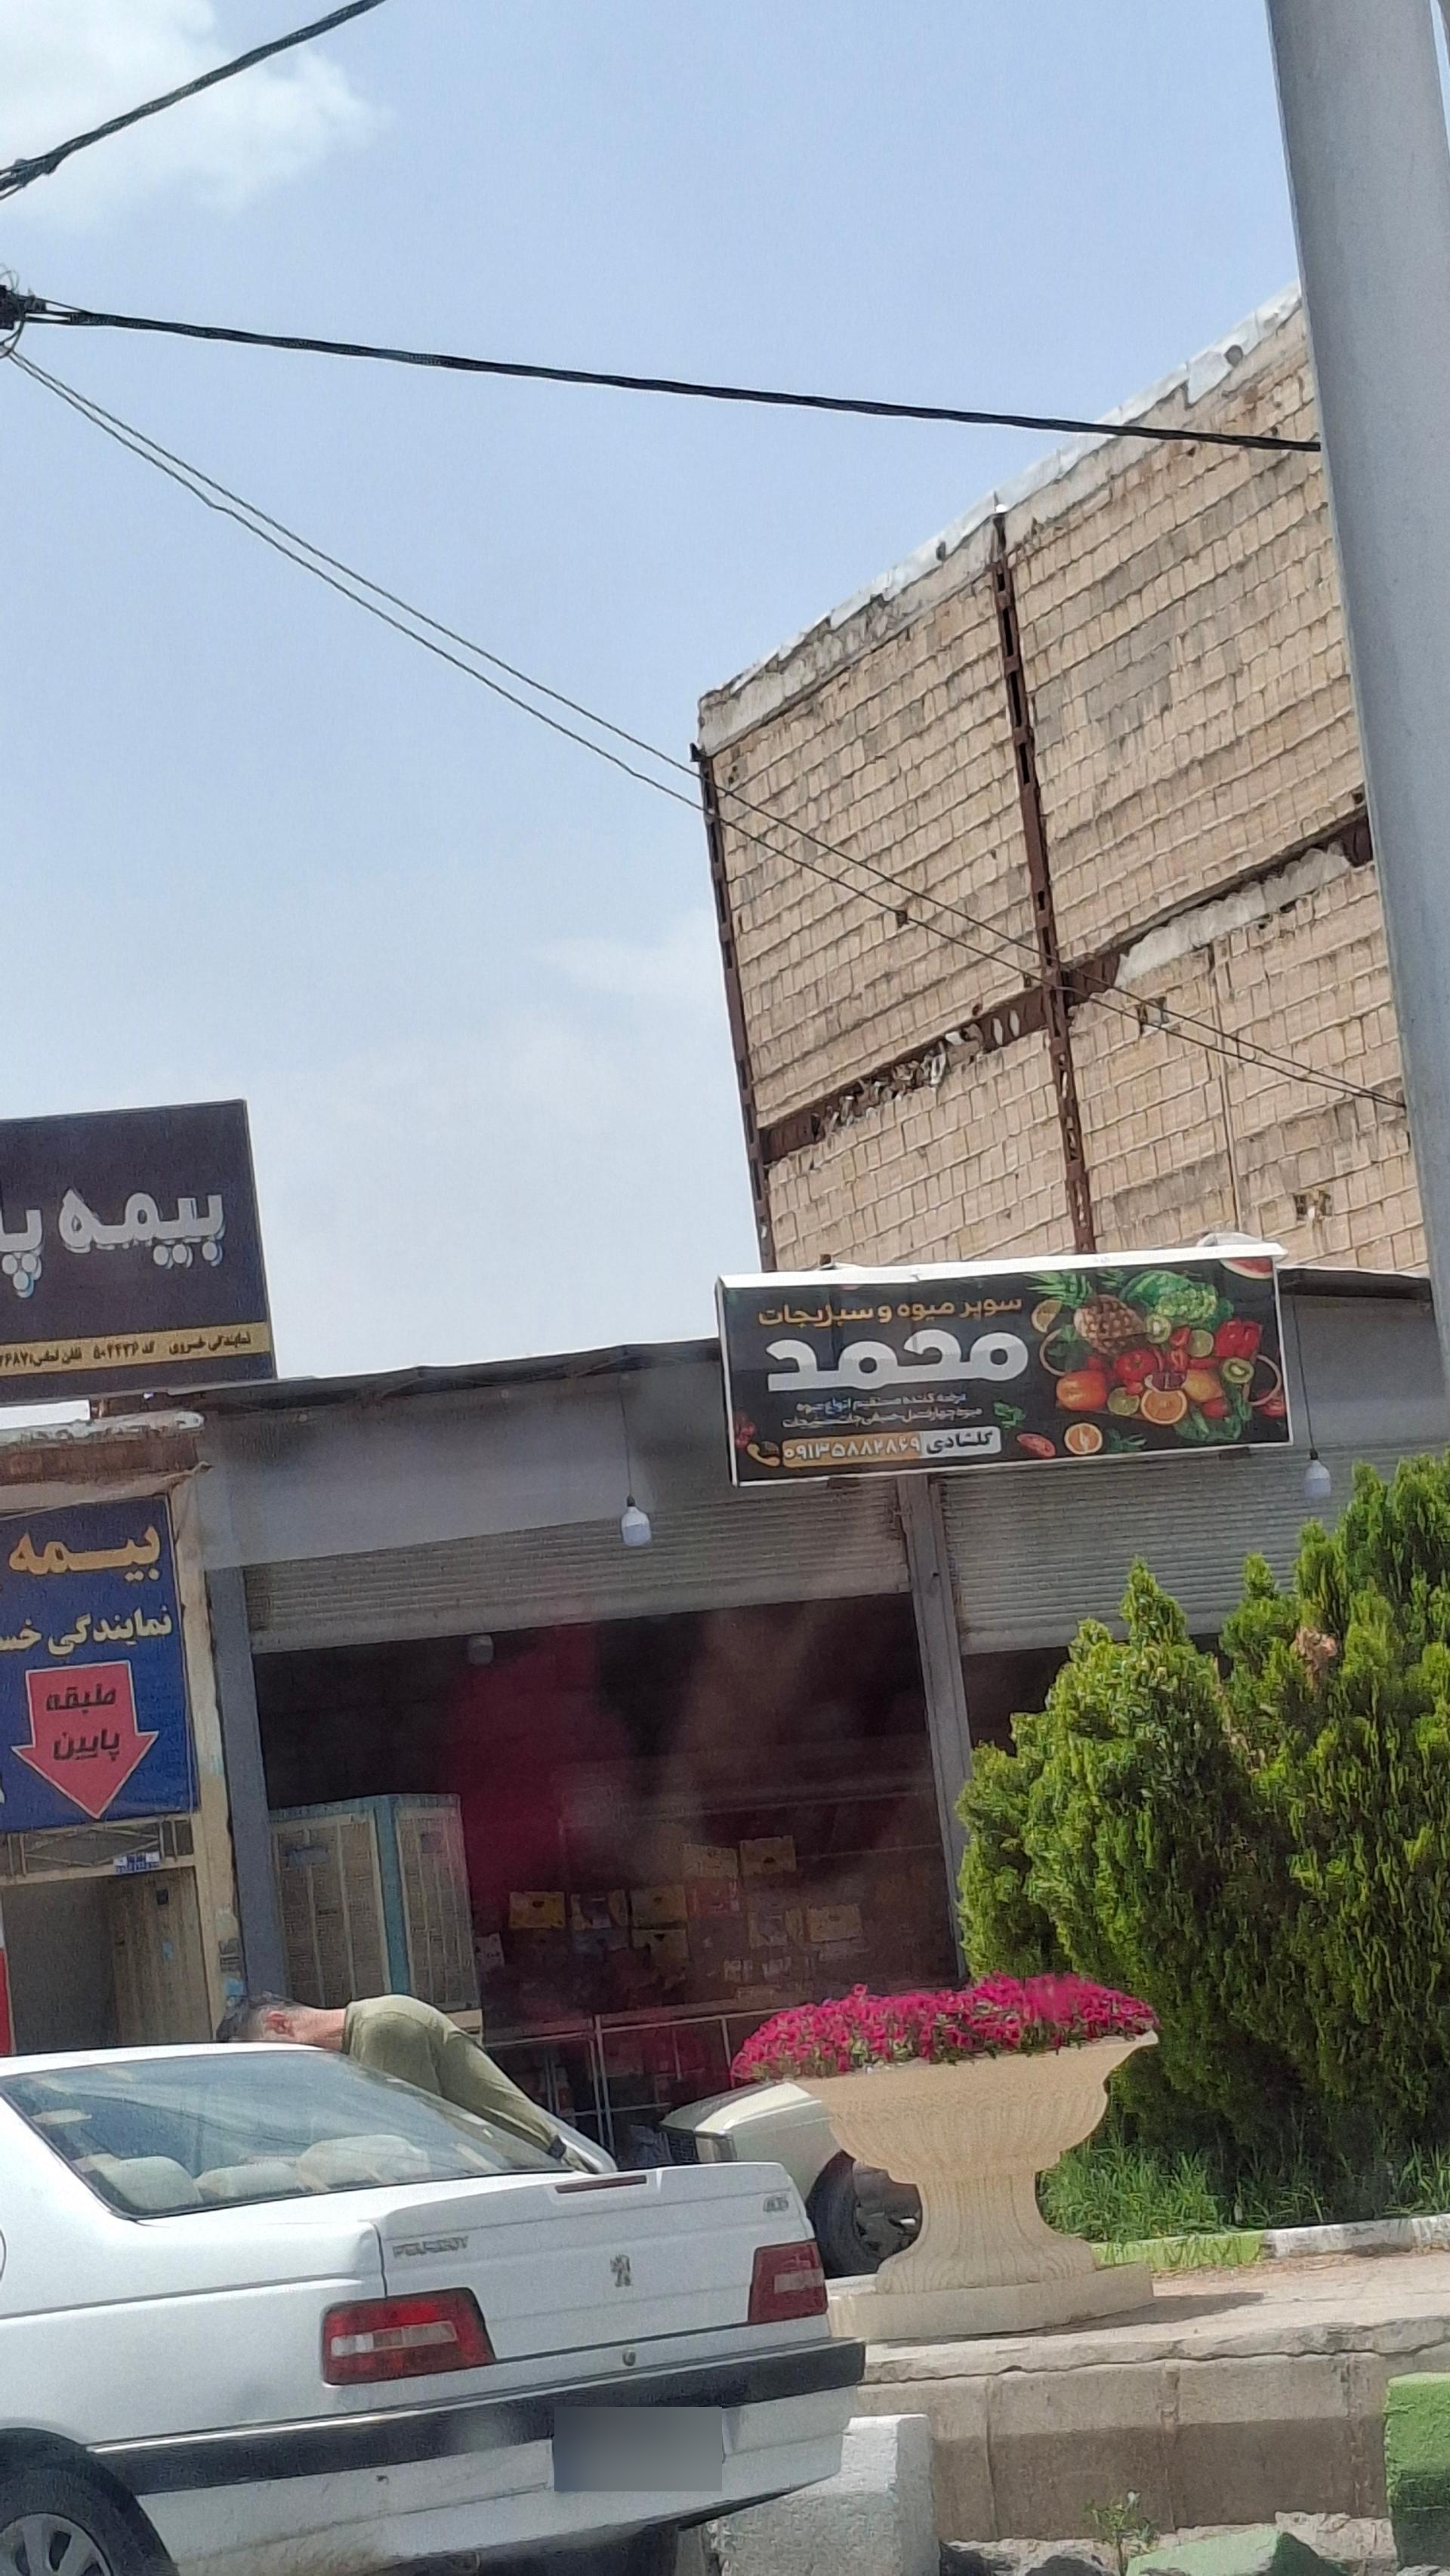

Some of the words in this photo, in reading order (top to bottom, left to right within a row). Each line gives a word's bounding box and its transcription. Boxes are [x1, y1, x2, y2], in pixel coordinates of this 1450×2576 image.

[59, 1188, 224, 1268] بیمه
[758, 1303, 874, 1328] سبزیجات
[878, 1305, 892, 1323] و
[897, 1301, 955, 1321] میوه
[960, 1297, 1023, 1320] سوپر
[765, 1329, 1029, 1391] محمد
[8, 1525, 162, 1582] بیمه
[48, 1604, 172, 1656] نمایندگی
[45, 1683, 116, 1715] طبقه
[53, 1727, 121, 1762] پایین
